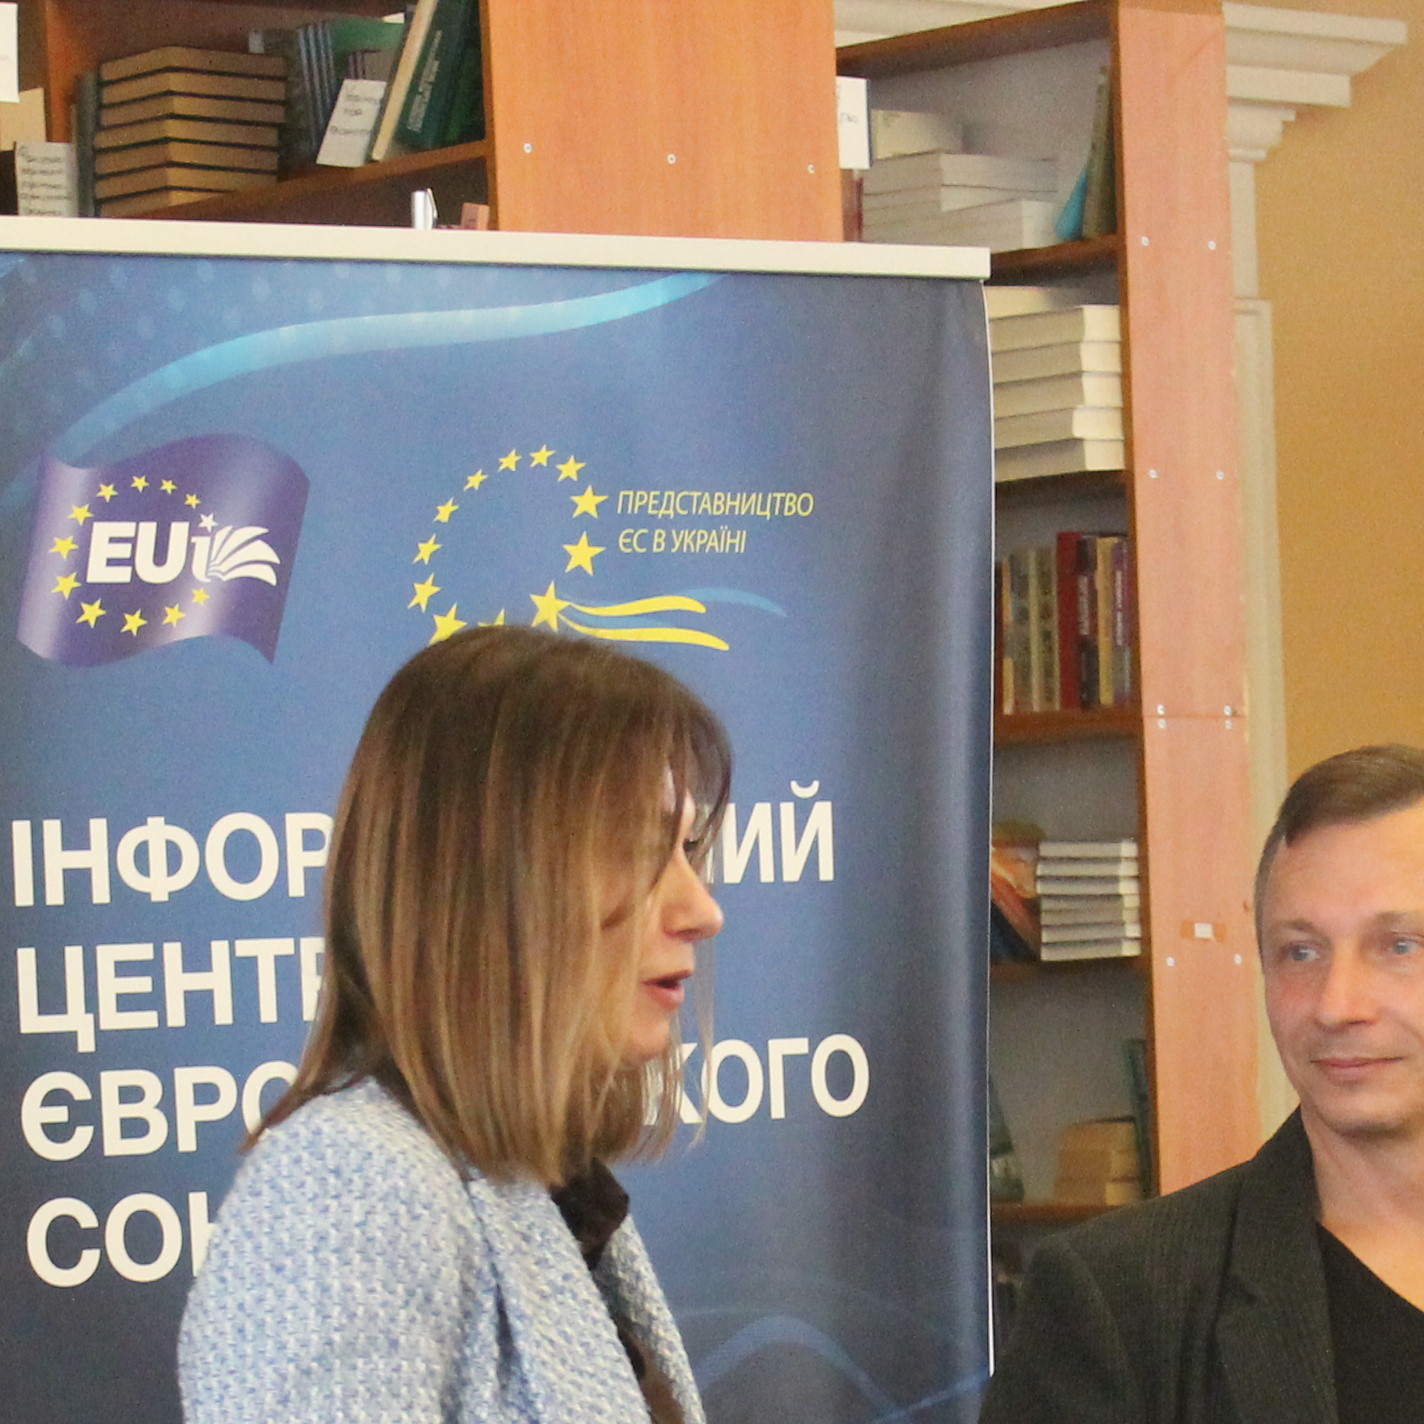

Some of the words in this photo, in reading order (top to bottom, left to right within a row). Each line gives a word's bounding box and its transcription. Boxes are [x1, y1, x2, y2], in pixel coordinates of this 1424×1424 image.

[617, 490, 815, 521] ПРЕДСТАВНИЦТВО
[618, 528, 649, 553] ЄС
[653, 528, 667, 553] В
[671, 525, 747, 553] УКРАЇНІ
